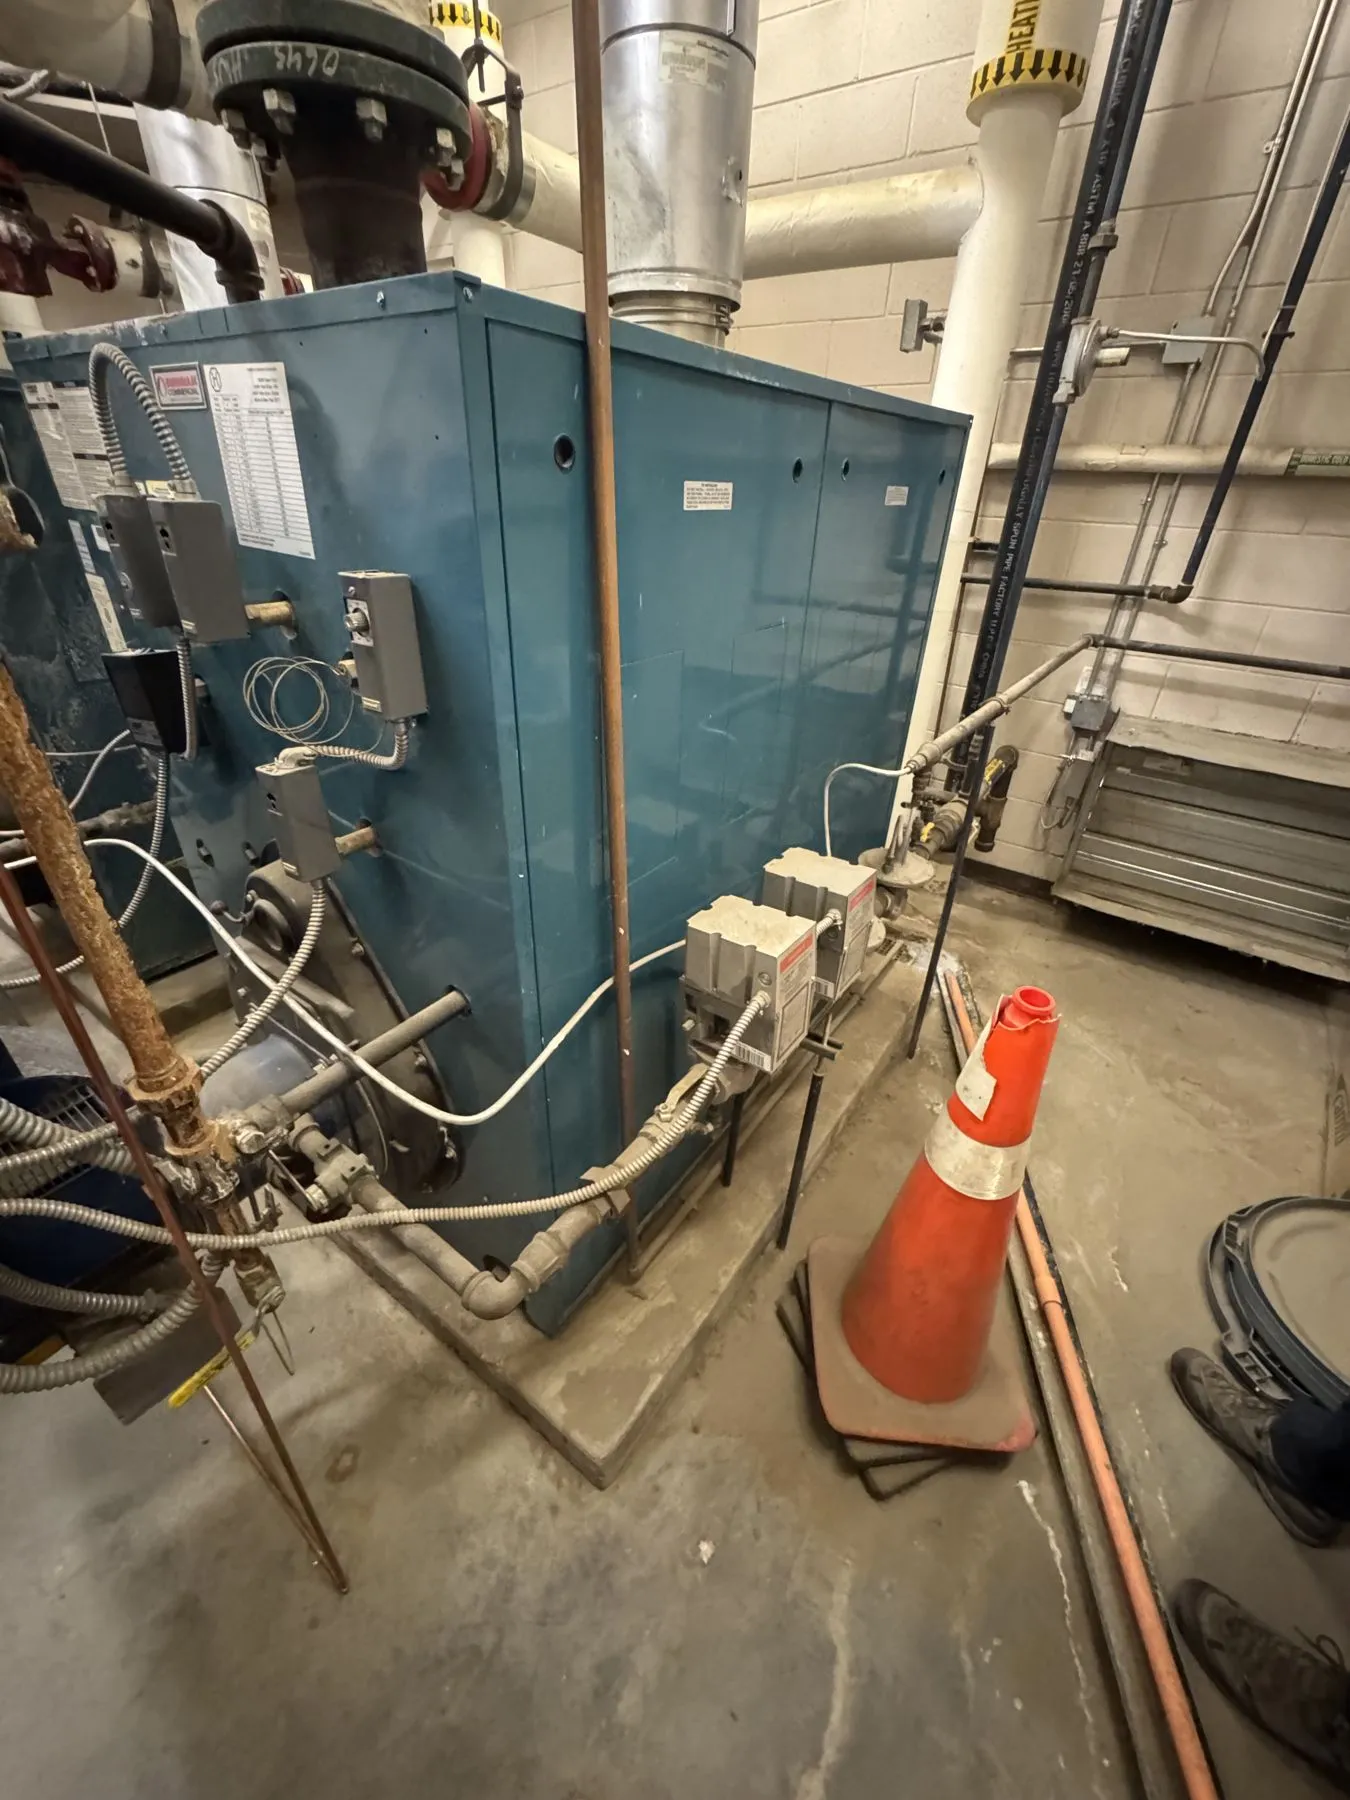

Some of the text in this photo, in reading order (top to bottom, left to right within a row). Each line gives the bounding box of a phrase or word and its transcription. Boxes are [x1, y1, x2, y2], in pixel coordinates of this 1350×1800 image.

[1085, 173, 1102, 215] ASTM
[1008, 522, 1021, 549] SPUN
[1003, 552, 1014, 572] PIPE
